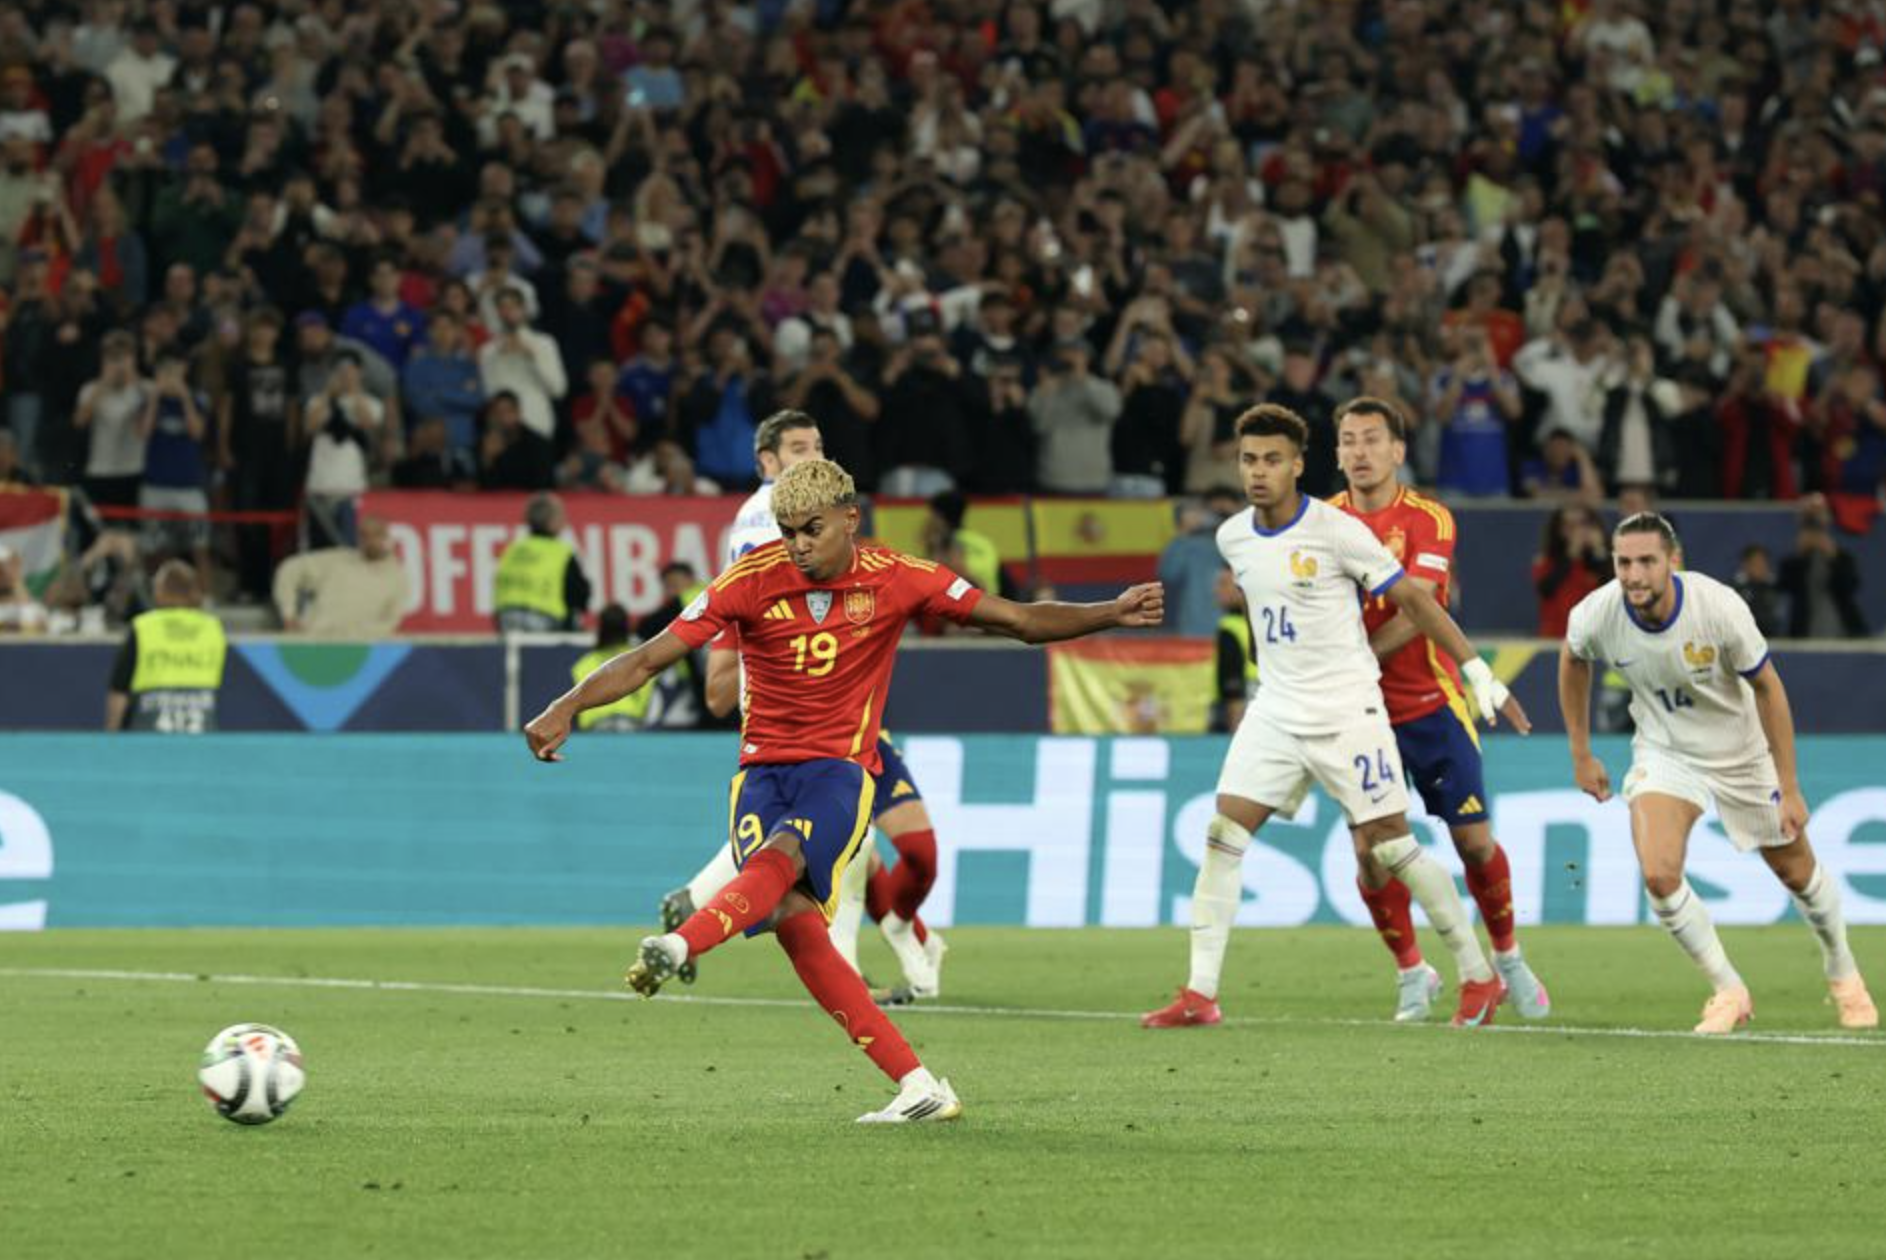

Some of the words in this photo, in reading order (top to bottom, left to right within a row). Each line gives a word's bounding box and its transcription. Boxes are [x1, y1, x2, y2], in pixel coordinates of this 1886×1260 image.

[1262, 605, 1297, 643] 24
[789, 632, 839, 677] 19
[1656, 687, 1694, 714] 14
[1353, 748, 1396, 792] 24
